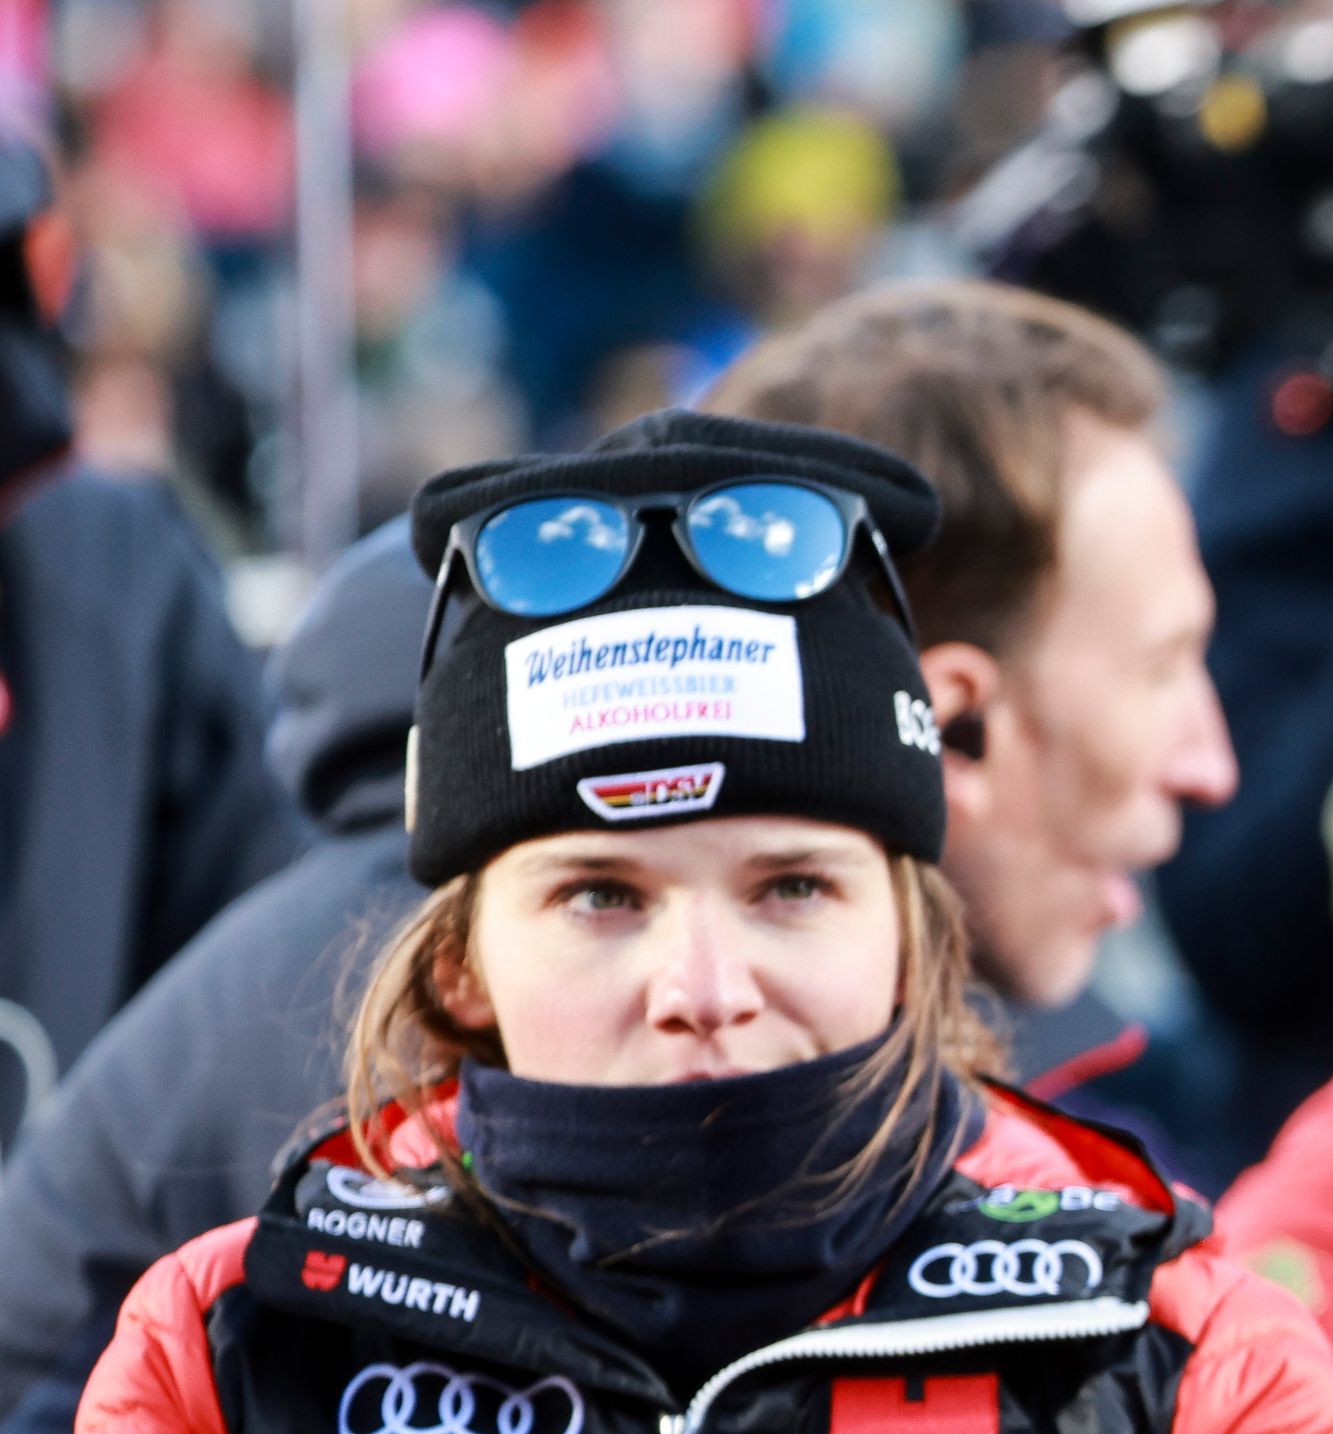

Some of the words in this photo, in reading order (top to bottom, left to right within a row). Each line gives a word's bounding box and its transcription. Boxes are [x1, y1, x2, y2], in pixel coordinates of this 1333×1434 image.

[524, 624, 776, 689] Weihenstephaner
[562, 674, 736, 709] HEFEWEISSBIER
[569, 701, 732, 735] ALKOHOLFREI
[307, 1207, 426, 1249] BOGNER
